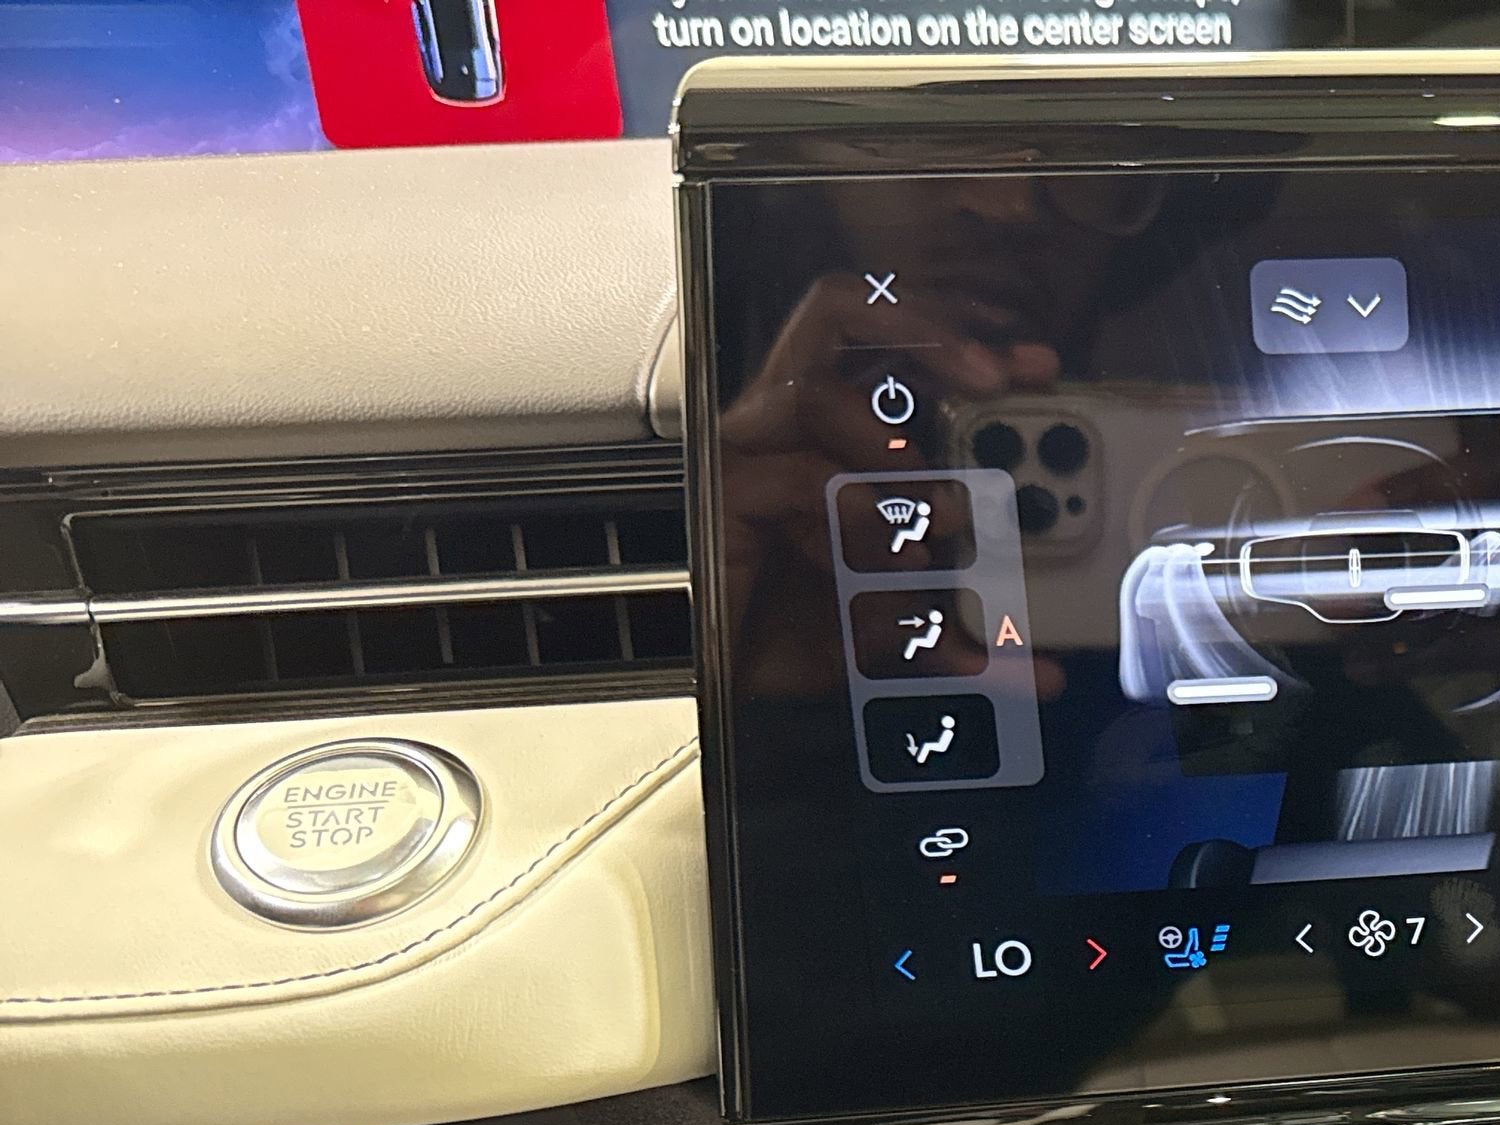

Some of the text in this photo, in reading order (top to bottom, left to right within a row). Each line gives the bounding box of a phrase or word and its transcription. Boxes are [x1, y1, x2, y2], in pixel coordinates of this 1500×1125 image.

[652, 6, 1232, 47] turn on location on the center screen
[996, 614, 1024, 647] A
[284, 780, 398, 803] ENGINE
[286, 806, 385, 829] START
[290, 826, 374, 848] STOP
[1406, 917, 1425, 945] 7
[973, 940, 1032, 978] LO
